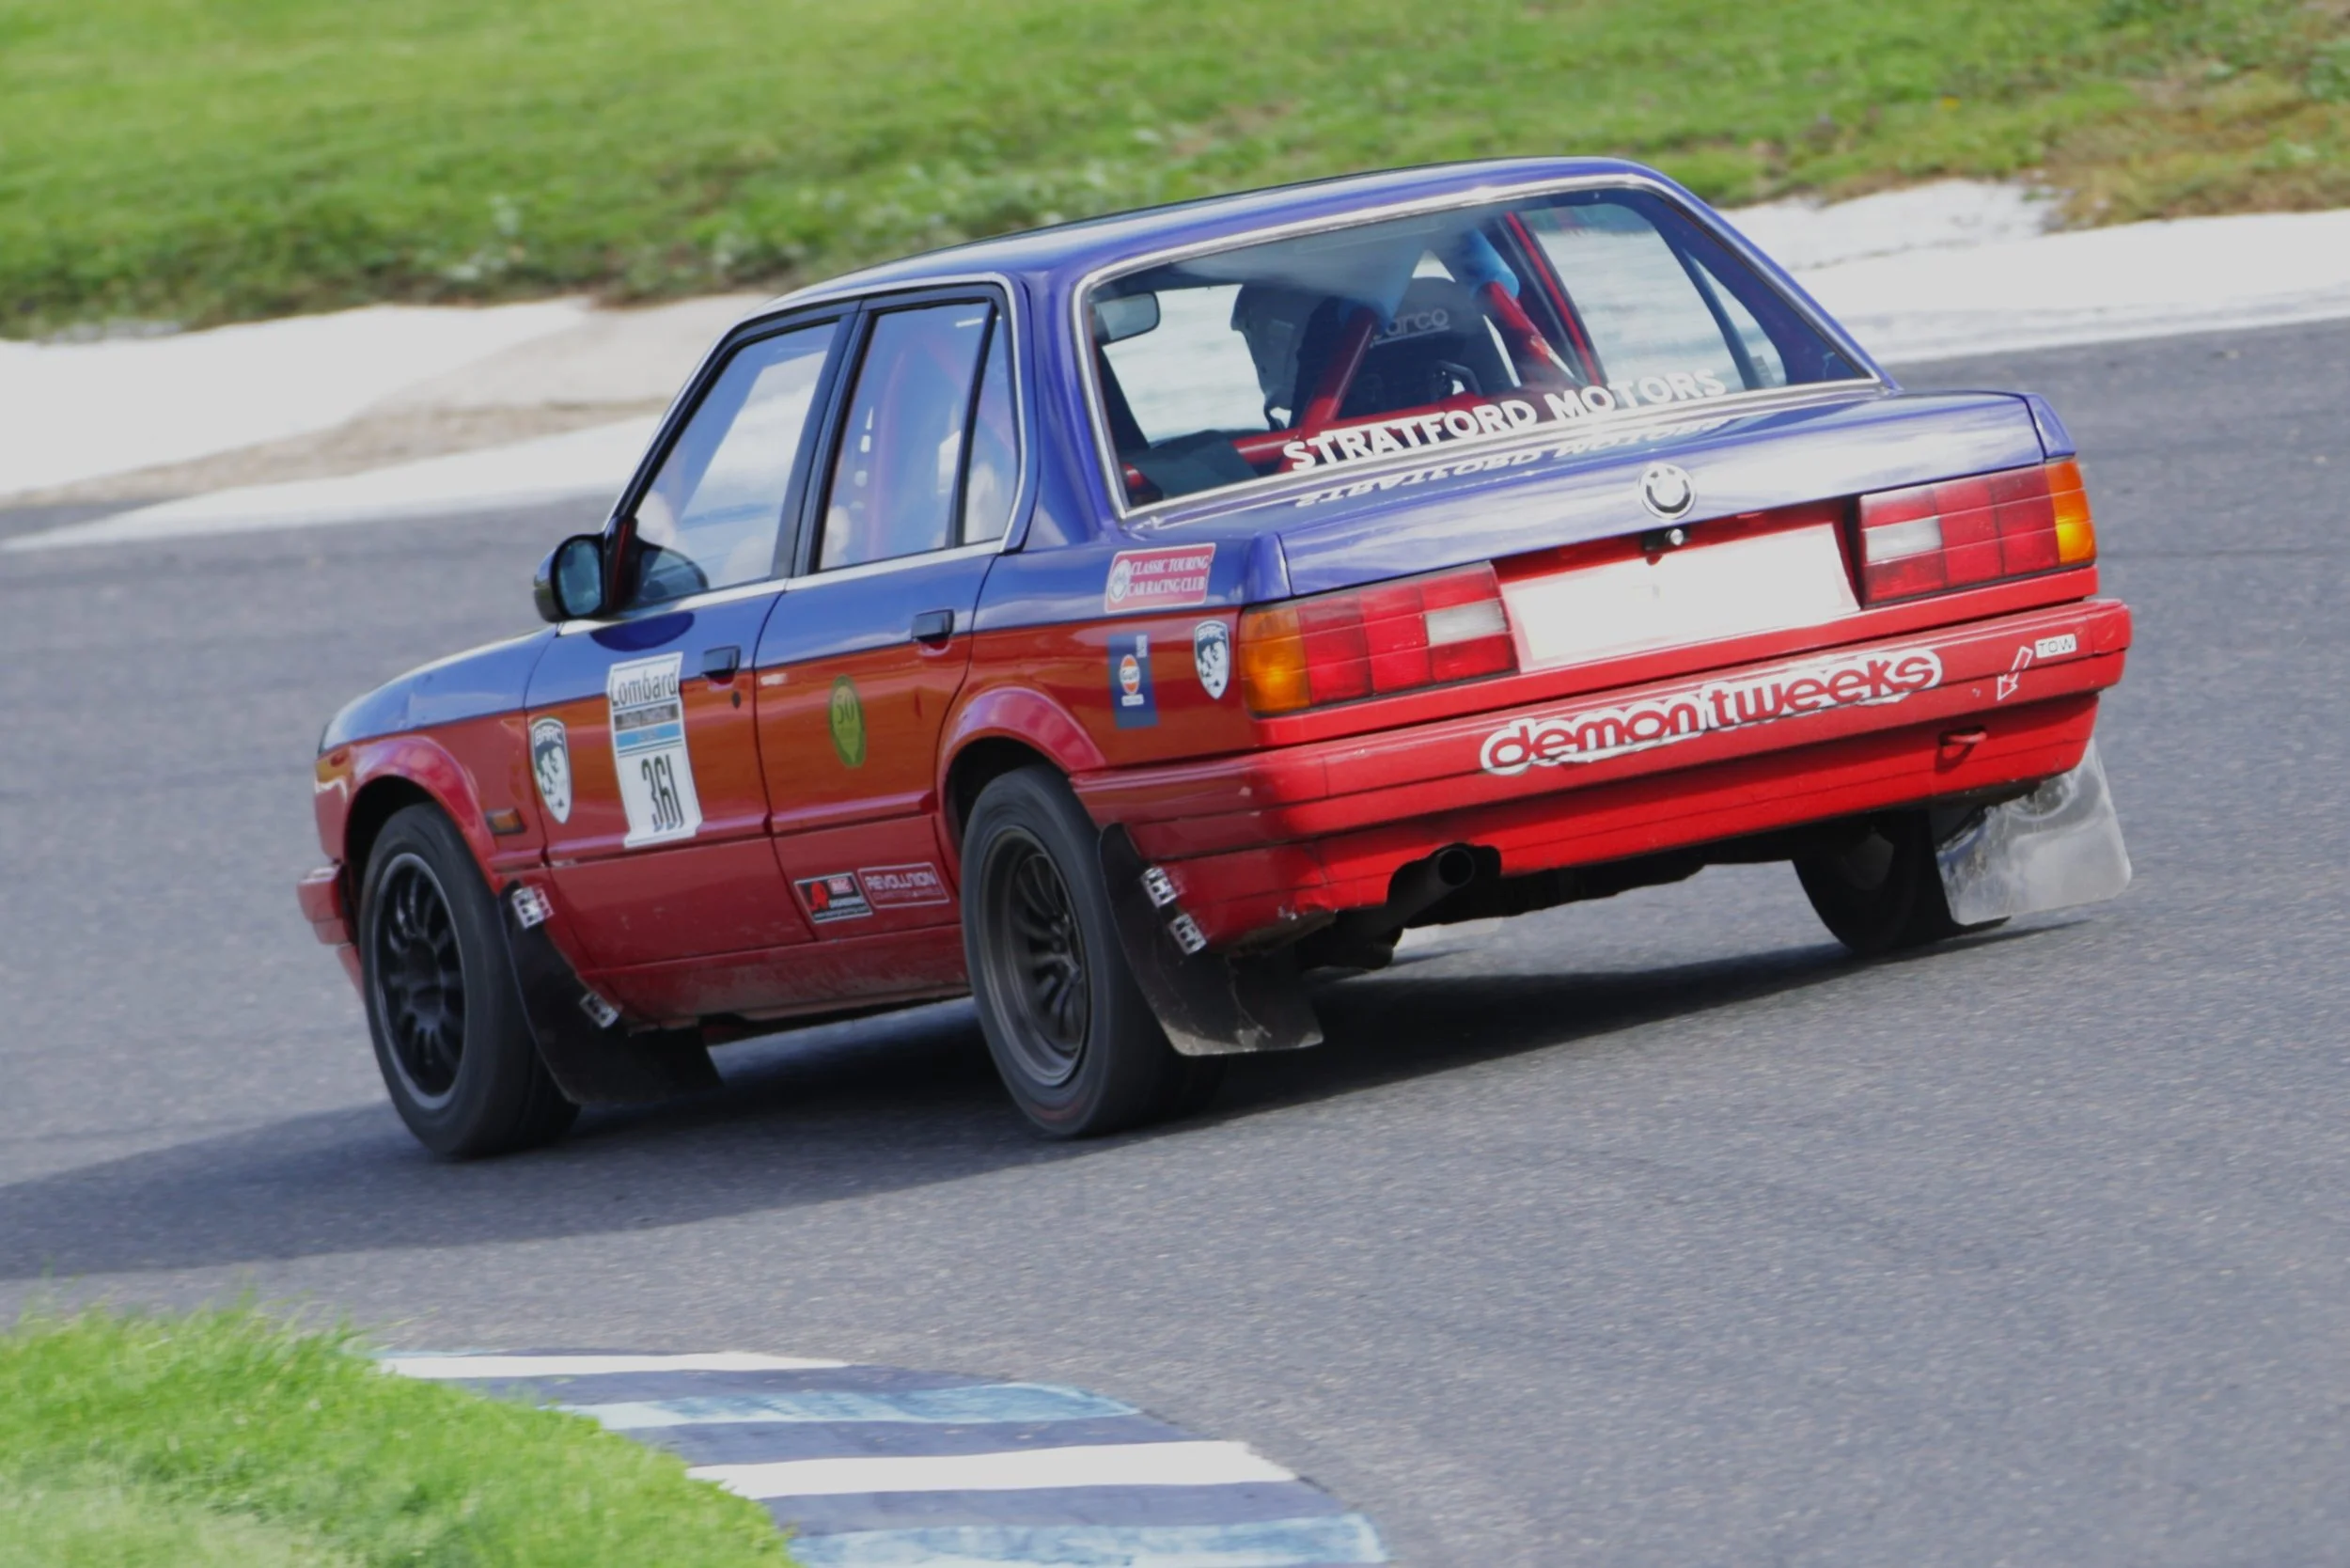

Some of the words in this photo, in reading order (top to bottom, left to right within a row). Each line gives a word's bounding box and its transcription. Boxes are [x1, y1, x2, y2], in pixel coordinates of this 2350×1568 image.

[1284, 399, 1538, 470] STRATFORD
[1543, 368, 1727, 422] MOTORS
[2038, 638, 2074, 655] TOW
[610, 665, 680, 708] Lombard
[534, 726, 564, 746] BARC
[641, 753, 685, 833] 361
[864, 870, 938, 892] REVOLUTION
